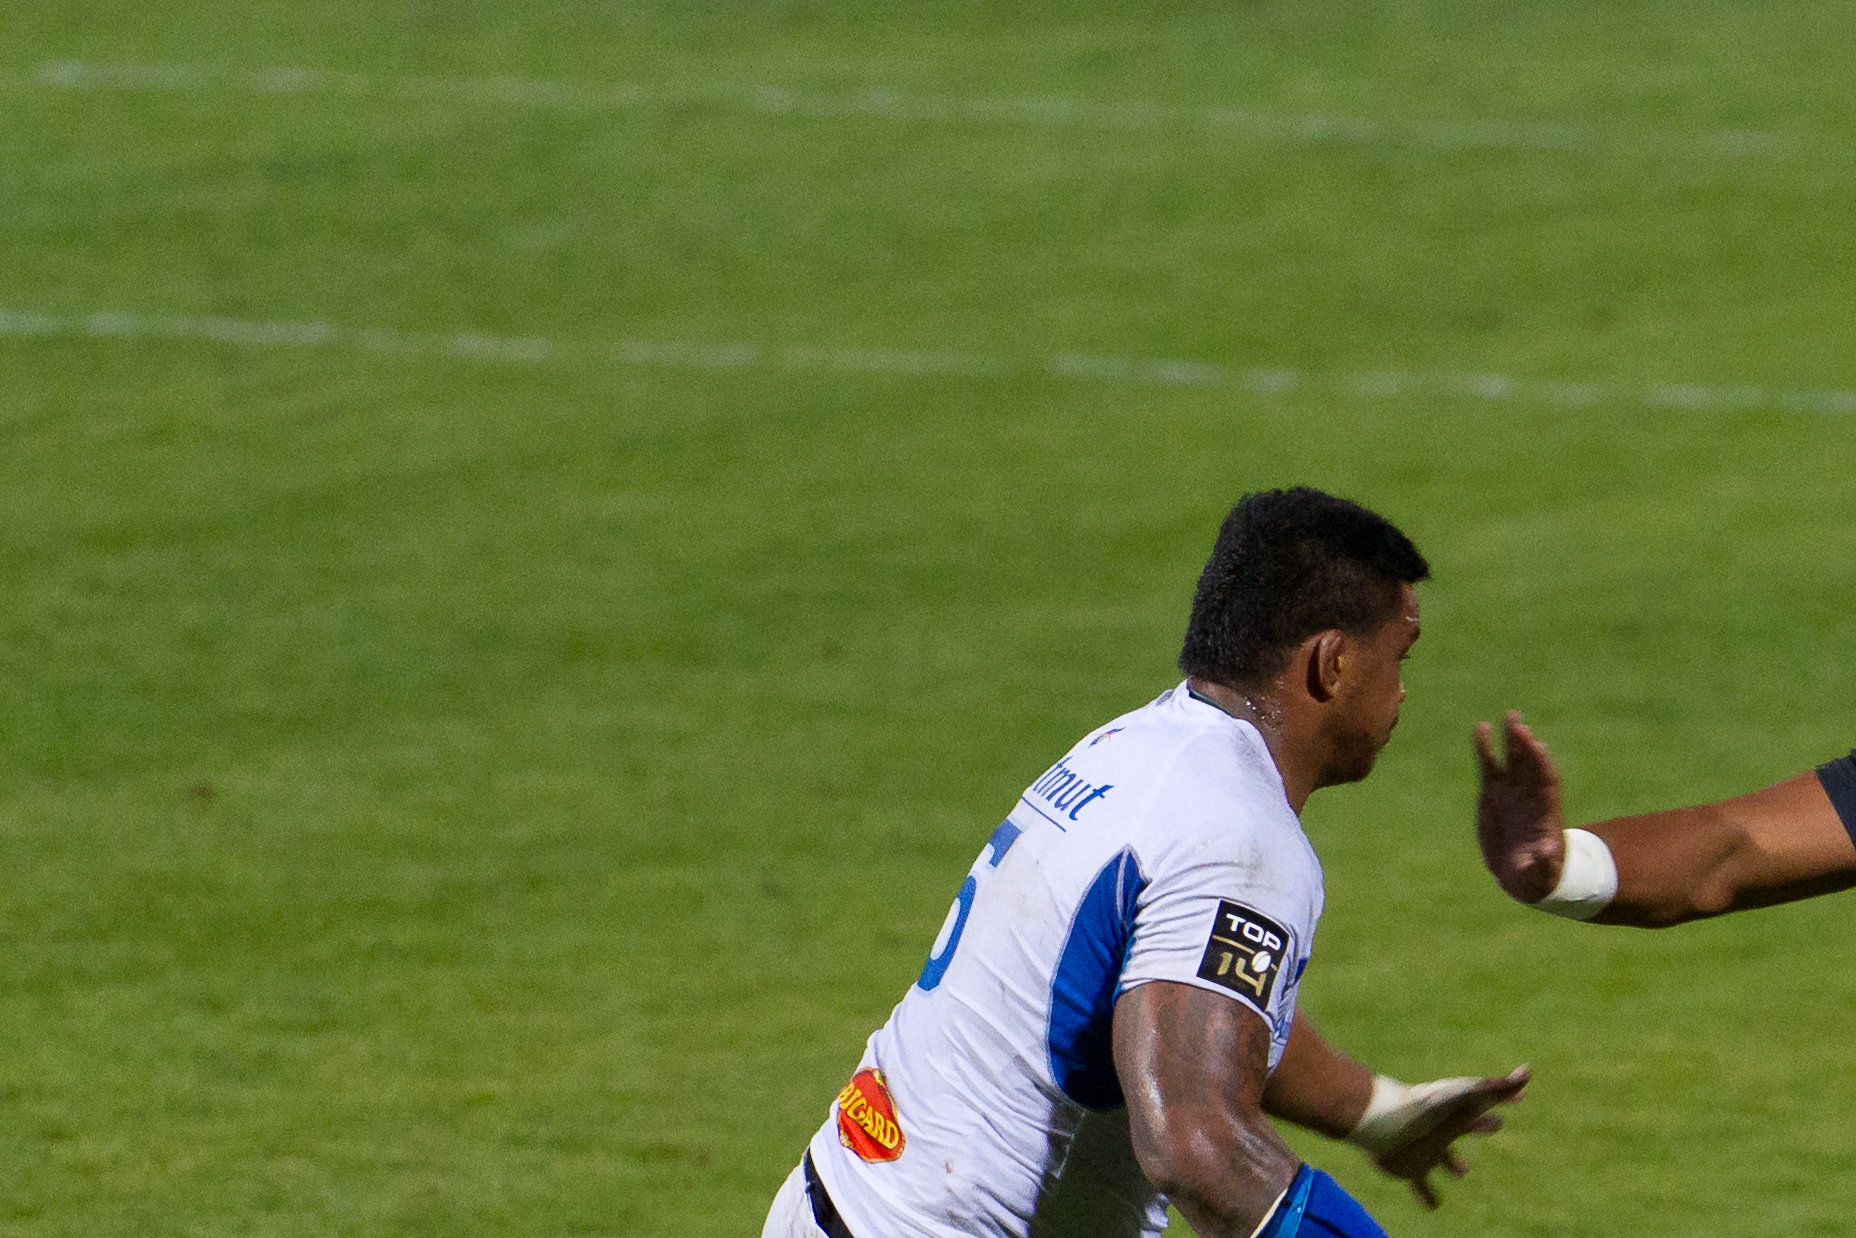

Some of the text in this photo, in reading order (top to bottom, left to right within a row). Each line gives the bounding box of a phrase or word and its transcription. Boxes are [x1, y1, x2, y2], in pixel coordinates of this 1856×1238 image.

[1226, 913, 1282, 951] TOP
[1217, 952, 1268, 998] 14
[837, 1082, 900, 1149] BIGARD
